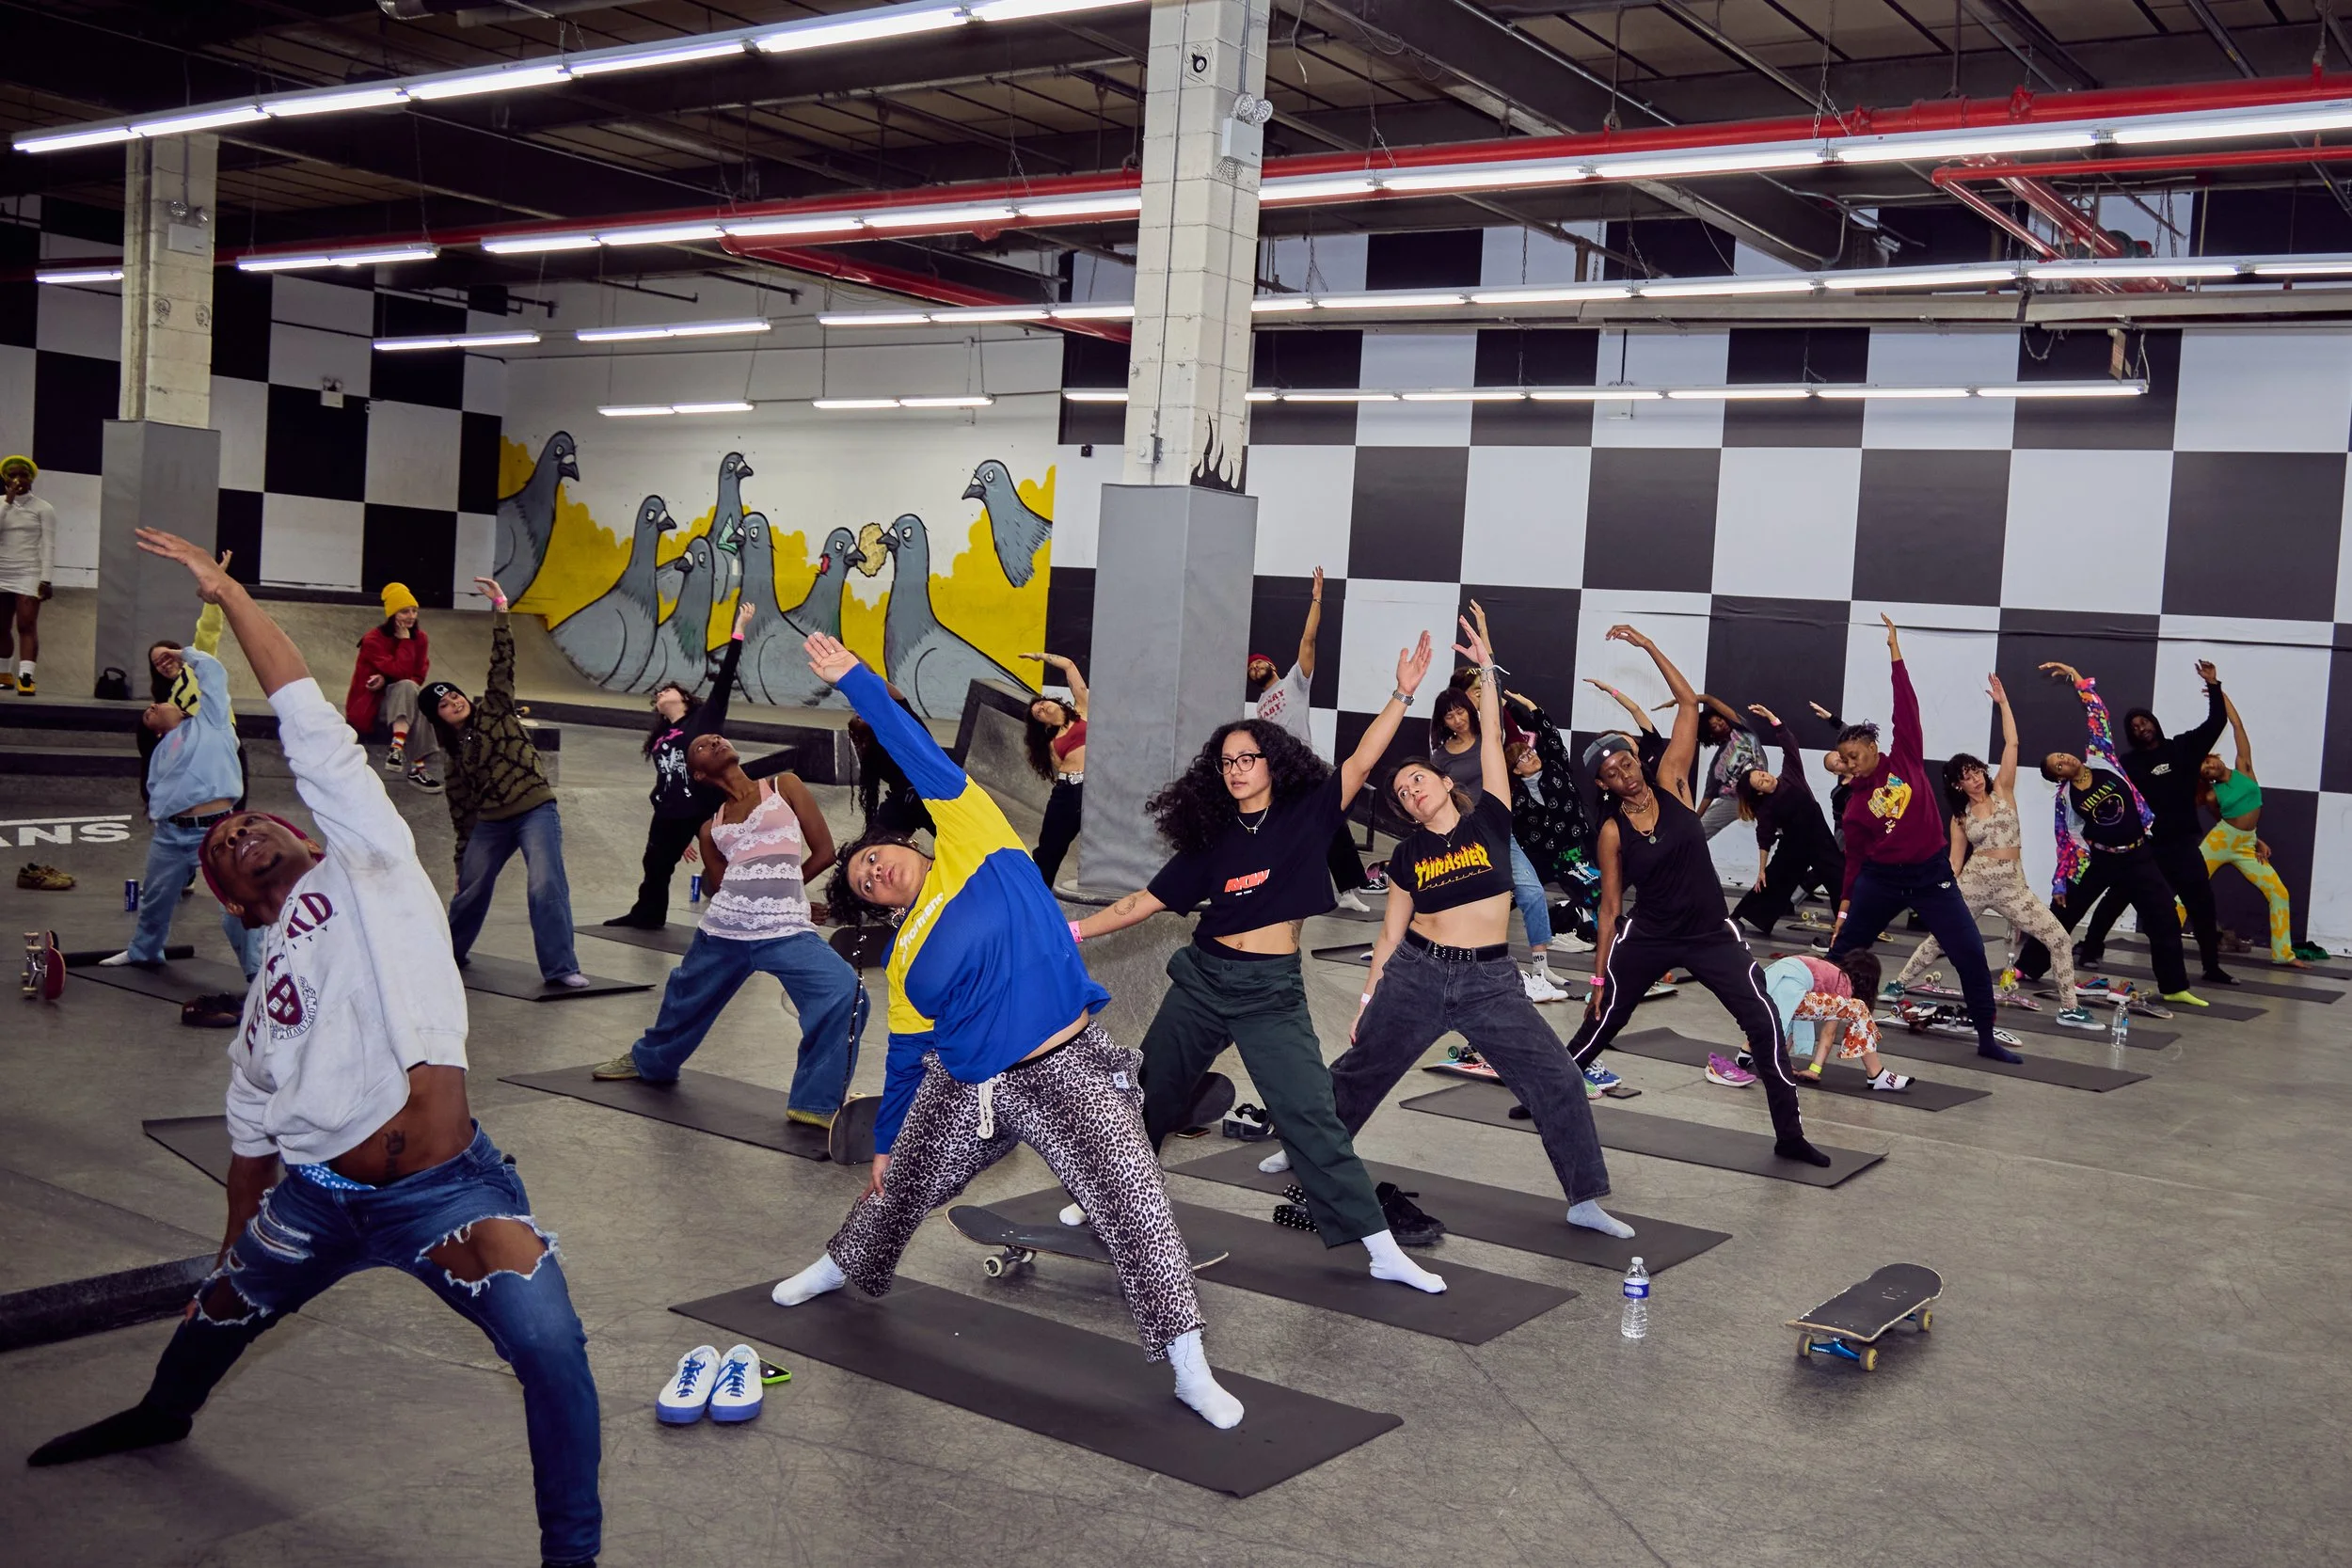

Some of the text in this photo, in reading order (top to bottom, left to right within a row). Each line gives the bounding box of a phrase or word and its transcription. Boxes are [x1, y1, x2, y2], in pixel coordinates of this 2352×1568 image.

[2080, 780, 2117, 812] NIRVANA
[0, 822, 130, 847] NS
[1414, 841, 1492, 890] THRASHER
